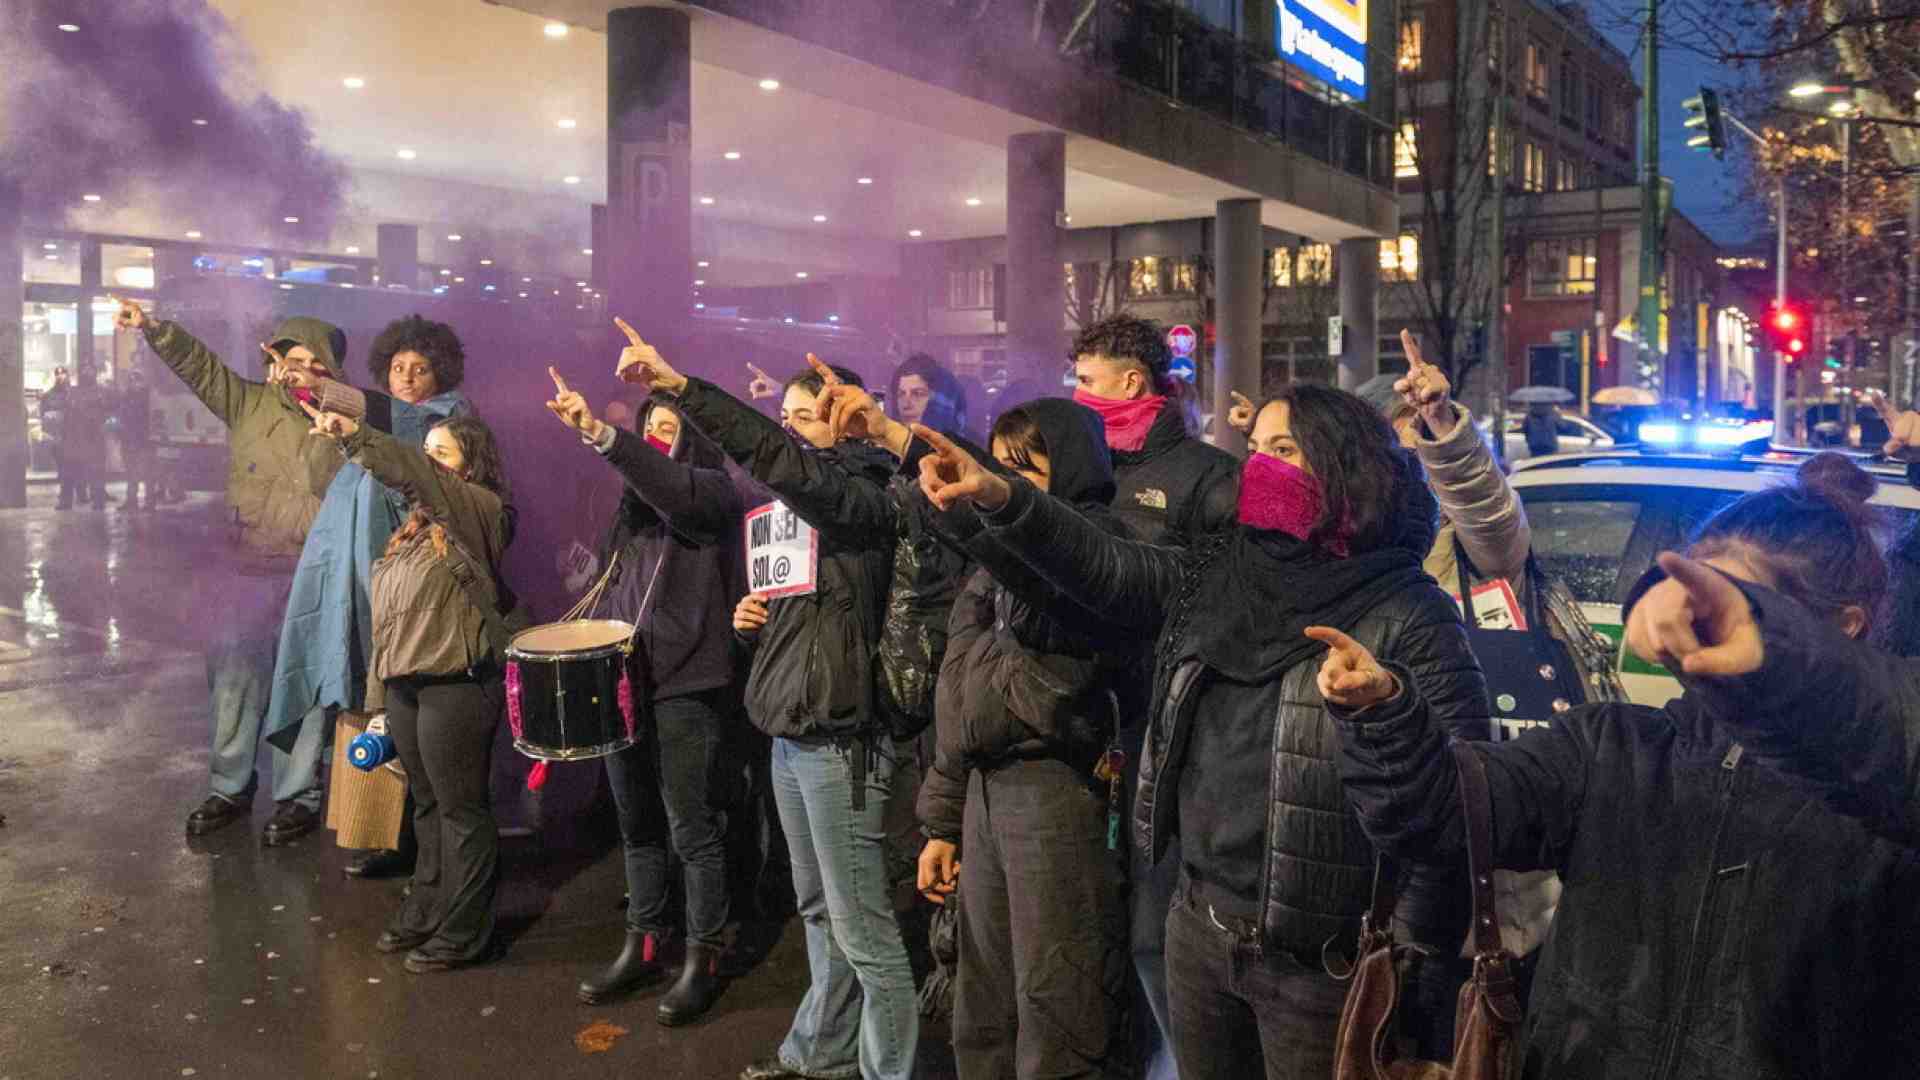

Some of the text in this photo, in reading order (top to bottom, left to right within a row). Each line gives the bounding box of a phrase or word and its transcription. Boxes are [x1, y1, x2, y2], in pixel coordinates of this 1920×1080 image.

[752, 510, 798, 549] NON SEI
[752, 554, 791, 589] SOL@
